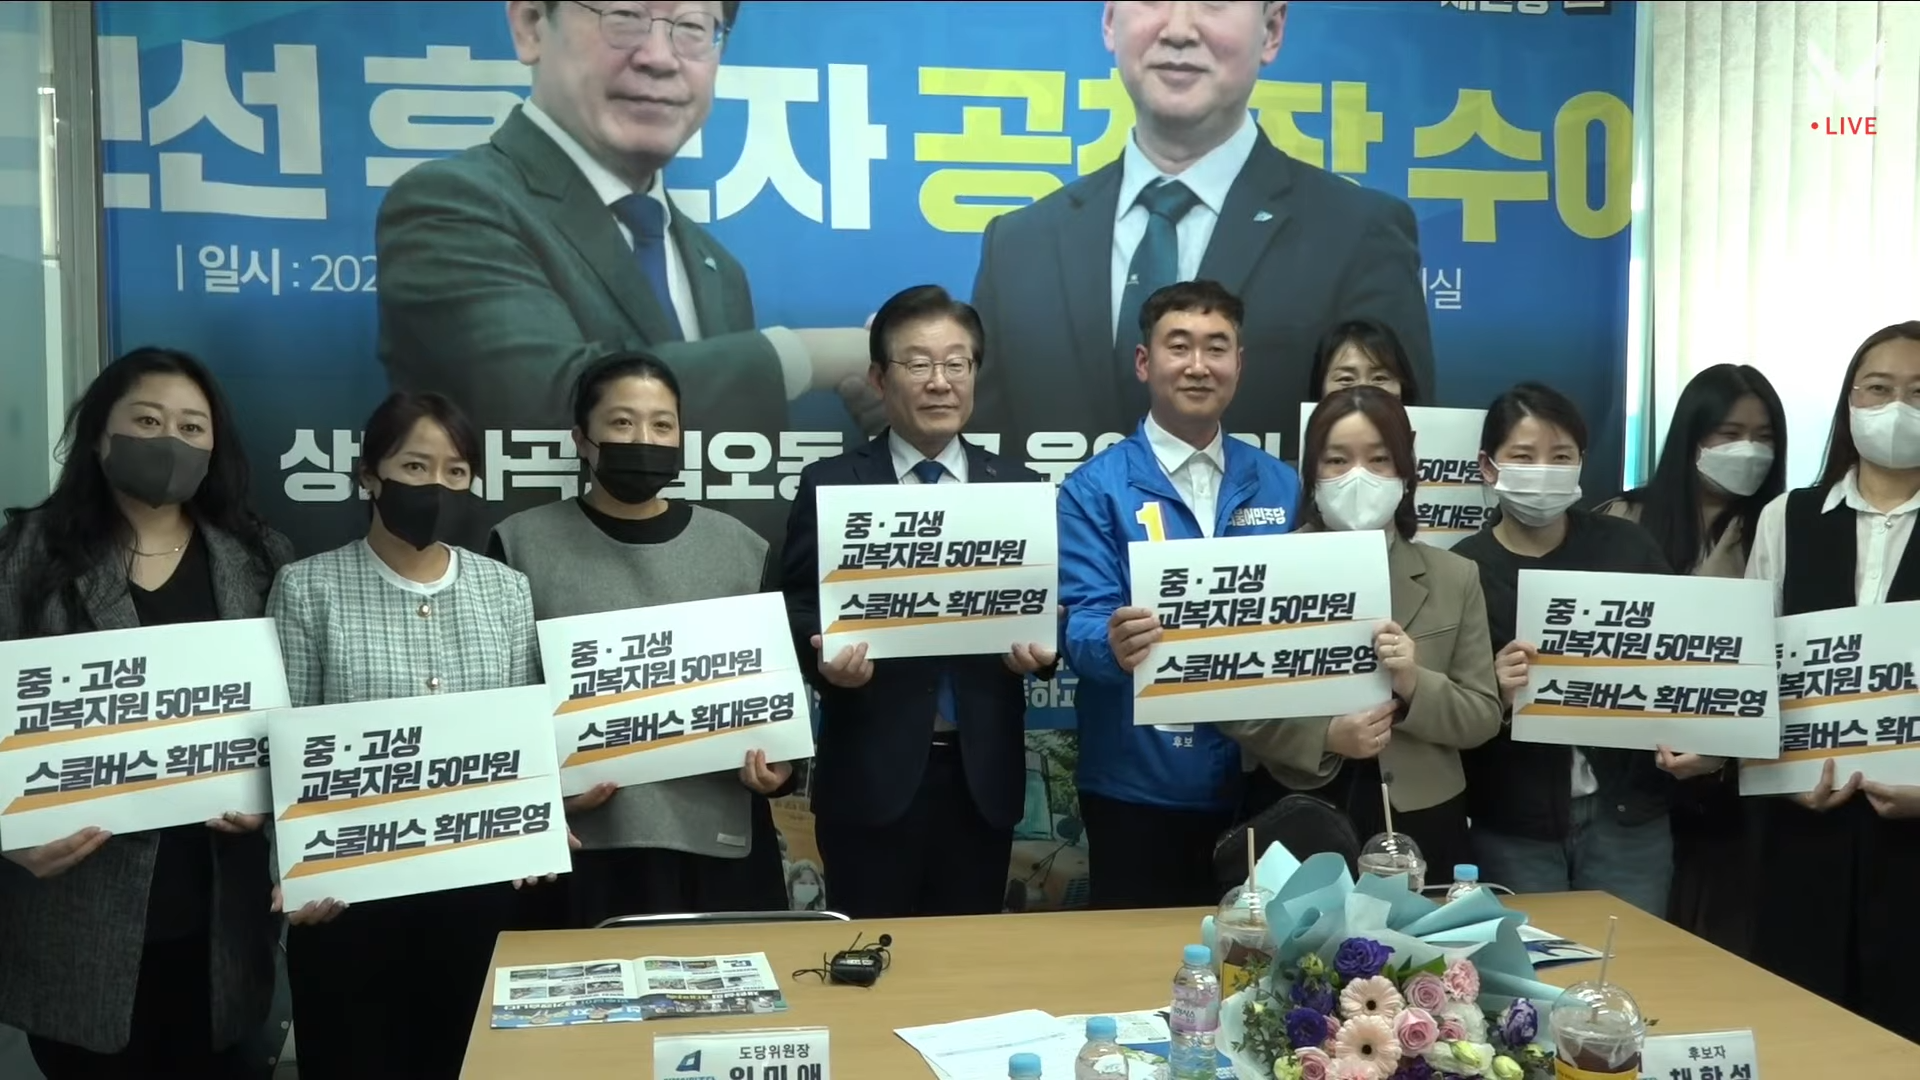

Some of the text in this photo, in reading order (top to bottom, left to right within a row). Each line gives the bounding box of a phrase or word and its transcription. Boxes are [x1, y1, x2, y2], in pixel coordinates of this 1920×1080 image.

[198, 244, 280, 296] 일시
[1417, 458, 1485, 484] 50만원
[844, 511, 873, 540] 중
[890, 510, 945, 538] 고생
[1136, 501, 1166, 542] 1
[837, 539, 1027, 570] 교복지원 50만원
[1159, 568, 1190, 598] 중
[1209, 564, 1267, 595] 고생
[838, 588, 1048, 620] 스쿨버스 확대운영
[1157, 592, 1357, 630] 교복지원 50만원
[1545, 598, 1577, 626] 중
[1595, 599, 1655, 629] 고생
[571, 639, 598, 669] 중
[619, 630, 673, 662] 고생
[1154, 645, 1379, 684] 스쿨버스 확대운영
[1536, 629, 1653, 661] 교복지원
[1653, 633, 1743, 664] 50만원
[1803, 634, 1863, 667] 고생
[17, 666, 52, 700] 중
[79, 656, 147, 693] 고생
[569, 647, 762, 701] 교복지원 50만원
[1779, 666, 1863, 699] 복지원
[14, 681, 251, 735] 교복지원 50만원
[1534, 679, 1769, 718] 스쿨버스 확대운영
[577, 692, 795, 753] 스쿨버스 확대운영
[1172, 735, 1194, 748] 후보
[1780, 719, 1868, 753] 쿨버스
[302, 734, 336, 768] 중
[358, 726, 422, 762] 고생
[24, 750, 158, 796] 스쿨버스
[297, 749, 520, 804] 교복지원 50만원
[302, 802, 551, 862] 스쿨버스 확대운영
[739, 1043, 810, 1061] 도당위원장
[1688, 1045, 1727, 1061] 후보자
